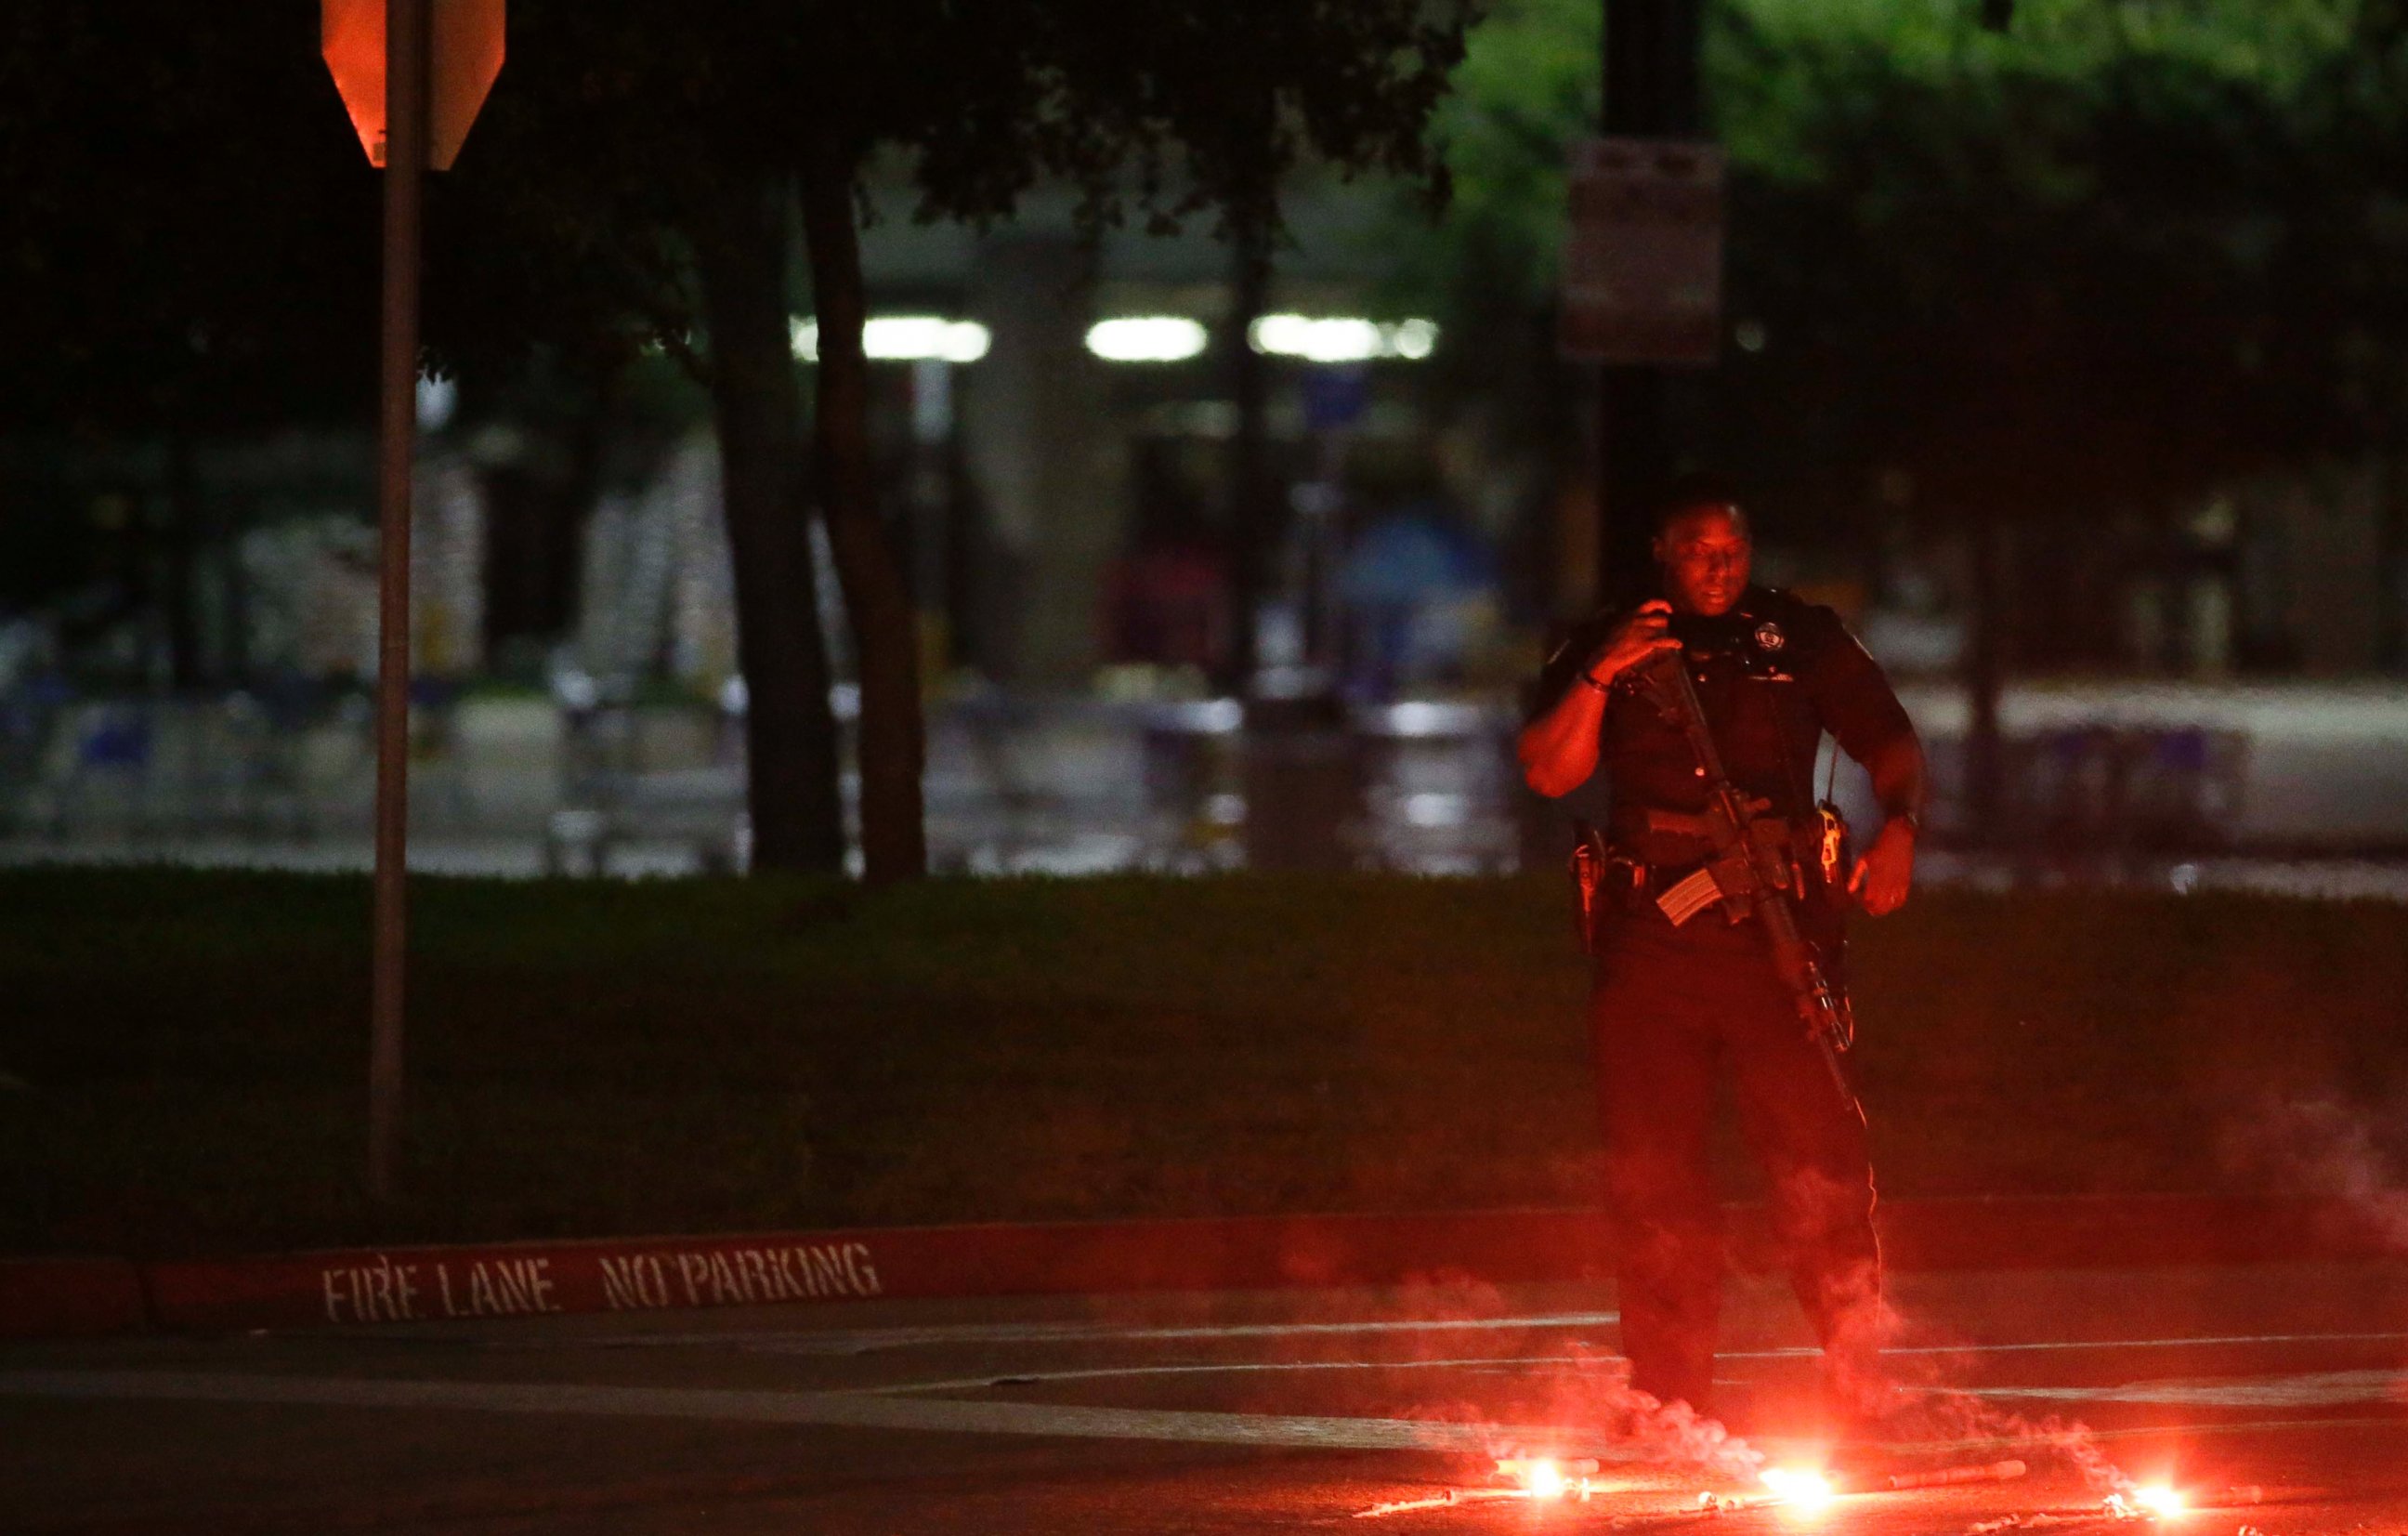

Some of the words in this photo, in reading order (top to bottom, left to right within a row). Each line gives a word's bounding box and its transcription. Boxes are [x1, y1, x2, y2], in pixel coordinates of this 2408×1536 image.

[323, 1254, 422, 1323] FIRE
[438, 1258, 561, 1317] LANE
[600, 1254, 669, 1310] NO
[679, 1242, 883, 1306] PARKING
